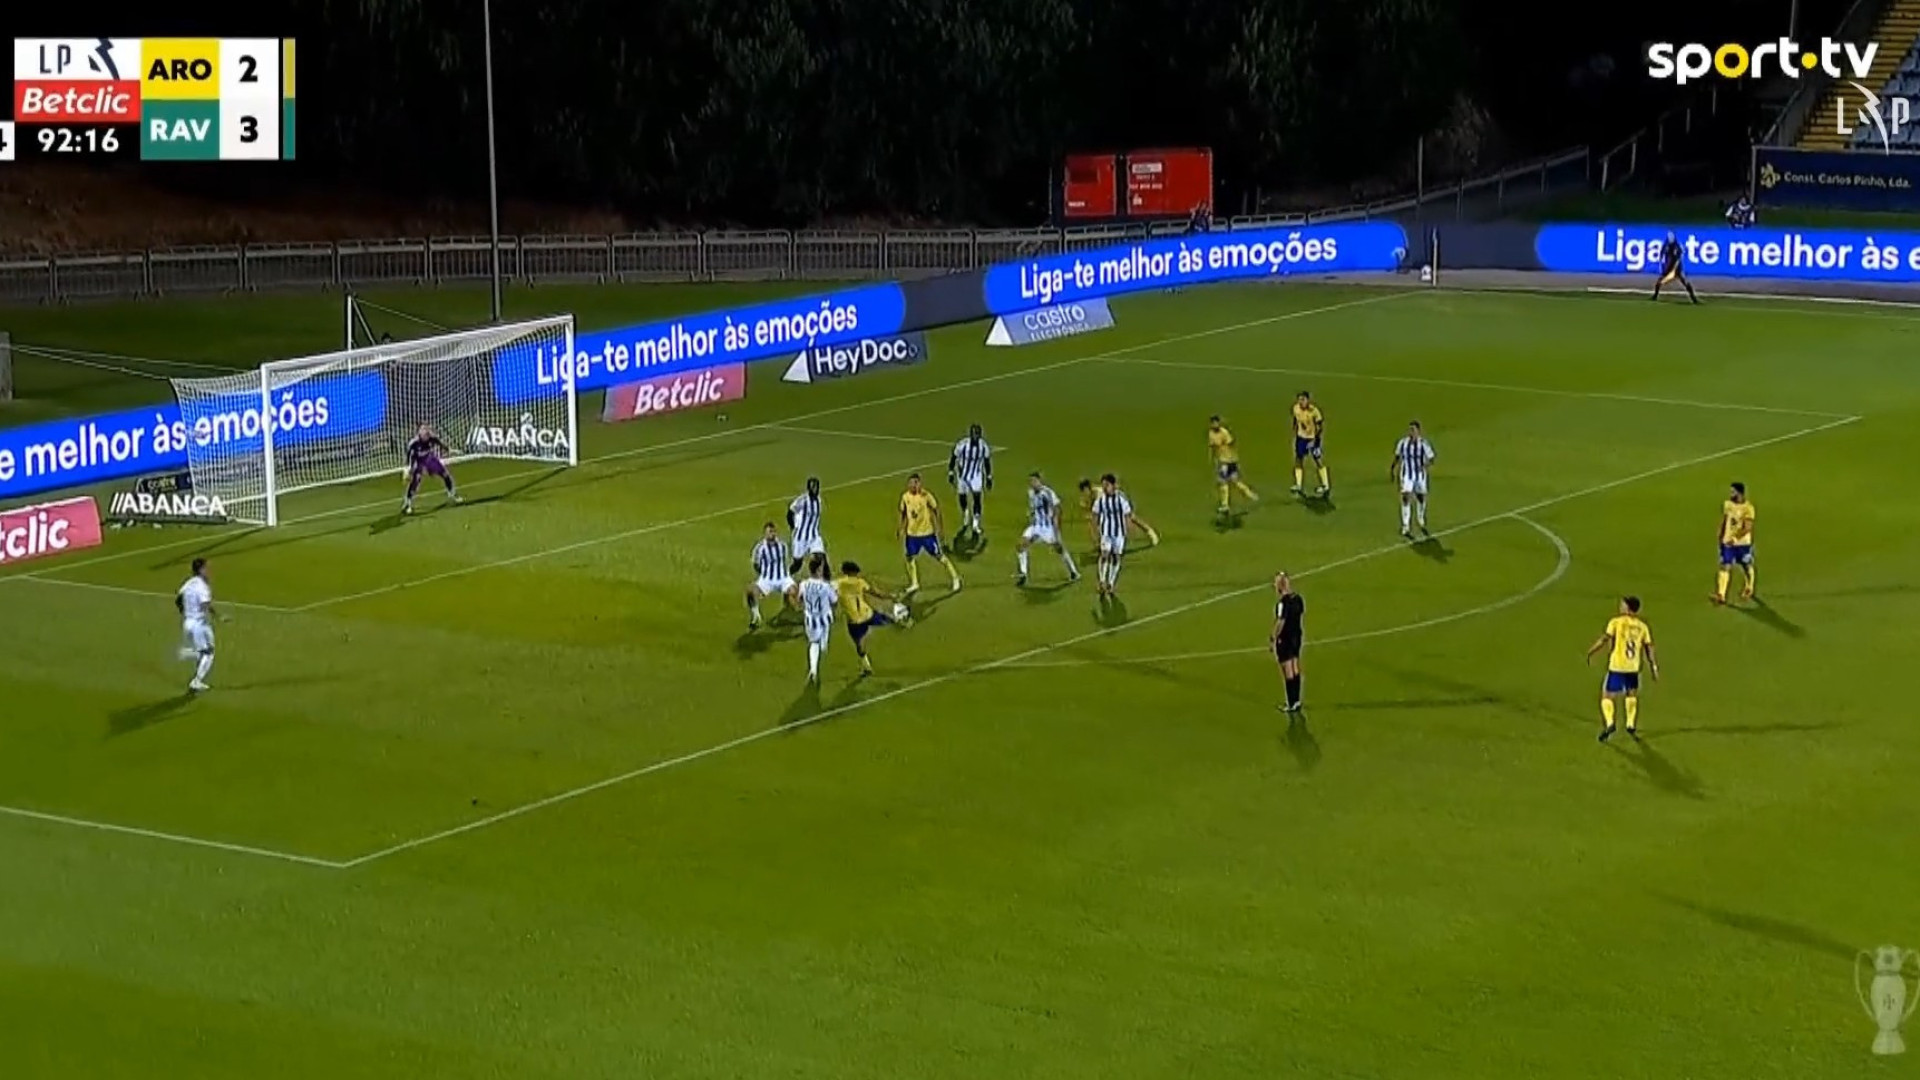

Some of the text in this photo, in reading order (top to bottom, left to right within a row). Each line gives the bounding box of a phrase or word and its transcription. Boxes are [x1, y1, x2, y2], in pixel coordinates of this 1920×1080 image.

[1818, 172, 1851, 186] Carlos
[1021, 231, 1337, 304] Liga-te melhor às emoções
[1728, 234, 1853, 268] melhor
[1860, 236, 1901, 271] às
[634, 323, 716, 369] melhor
[723, 314, 749, 353] às
[754, 300, 858, 348] emoções
[1024, 302, 1085, 331] castro
[633, 373, 725, 416] Betclic
[25, 423, 145, 477] melhor
[153, 413, 186, 453] às
[1625, 639, 1636, 660] 8
